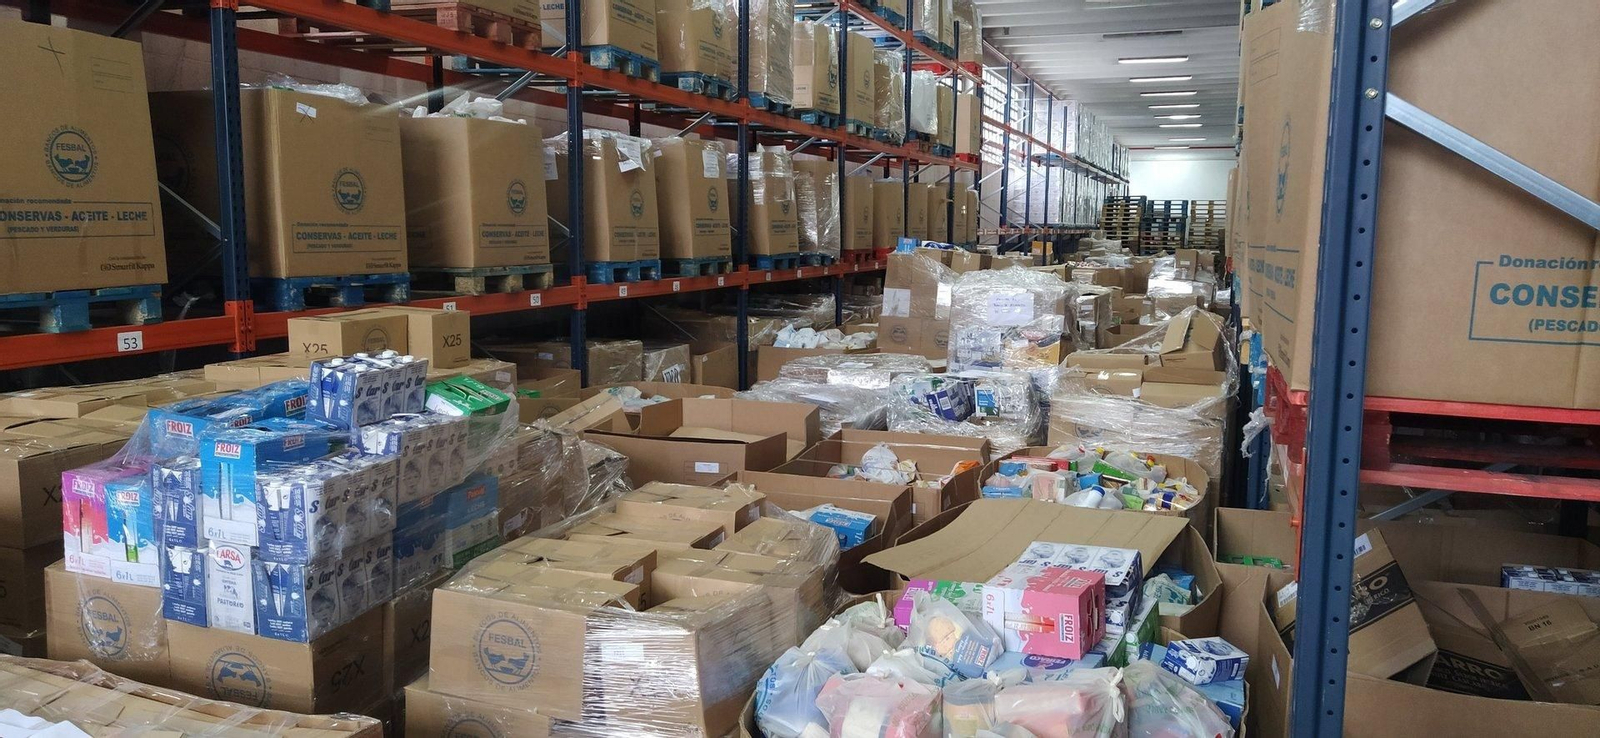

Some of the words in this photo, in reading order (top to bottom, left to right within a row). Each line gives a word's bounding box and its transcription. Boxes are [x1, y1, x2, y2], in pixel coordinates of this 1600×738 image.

[56, 142, 87, 152] FESBAL
[71, 210, 108, 222] ACEITE
[117, 210, 147, 221] LECHE
[296, 232, 342, 240] CONSERVAS
[1499, 254, 1589, 270] Donación
[123, 337, 138, 349] 53
[442, 334, 462, 348] X25
[166, 420, 192, 435] FROIZ
[284, 435, 304, 447] FROIZ
[216, 442, 240, 454] FROIZ
[73, 480, 94, 492] FROIZ
[117, 491, 138, 501] FROIZ
[1064, 615, 1074, 642] FROIZ
[488, 633, 527, 648] FESBAL
[976, 646, 988, 666] FROIZ
